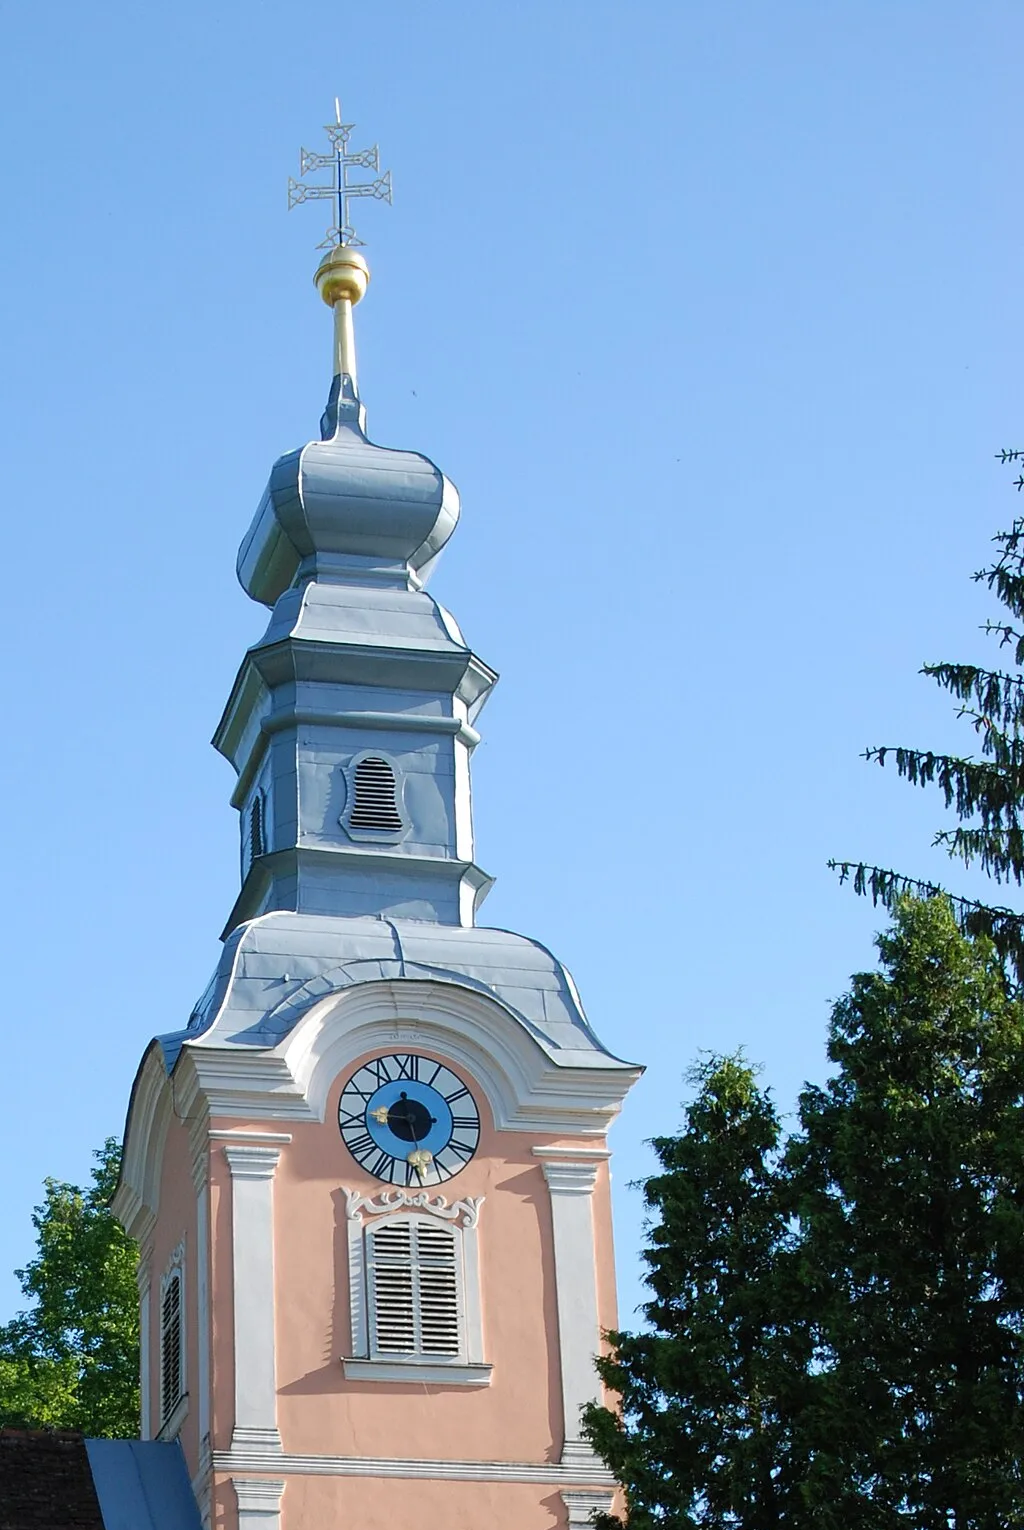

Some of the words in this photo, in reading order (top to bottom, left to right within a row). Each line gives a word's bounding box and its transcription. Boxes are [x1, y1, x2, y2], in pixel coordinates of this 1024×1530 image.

[364, 1059, 392, 1087] XI
[393, 1055, 418, 1080] XII
[428, 1064, 442, 1085] I
[343, 1080, 374, 1103] X
[445, 1086, 470, 1103] II
[340, 1109, 366, 1129] IX
[452, 1117, 480, 1129] III
[347, 1133, 377, 1164] VIII
[448, 1139, 475, 1164] IV
[371, 1152, 395, 1183] VII
[433, 1156, 453, 1183] V
